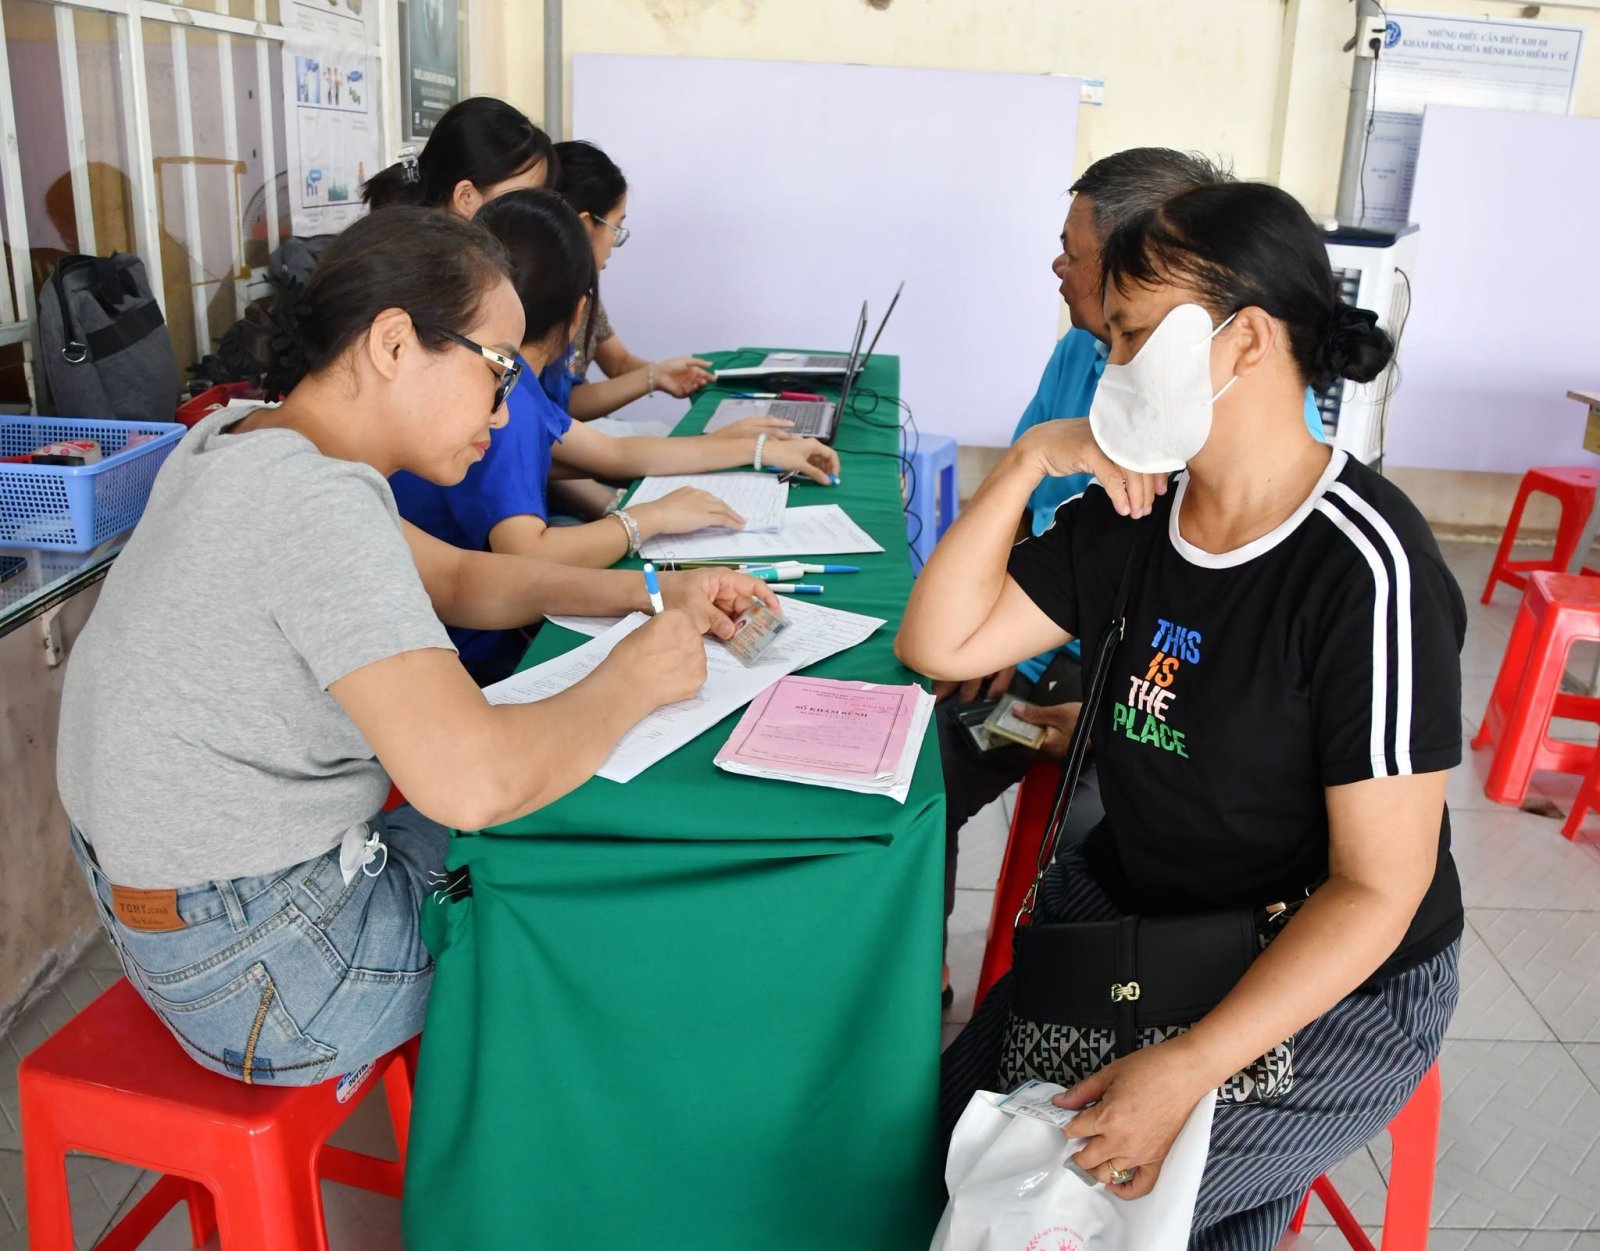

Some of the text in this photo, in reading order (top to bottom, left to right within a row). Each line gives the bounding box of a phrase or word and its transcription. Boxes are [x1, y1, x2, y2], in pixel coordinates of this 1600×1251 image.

[1151, 618, 1202, 665] THIS
[1145, 651, 1180, 688] IS
[1128, 675, 1176, 722] THE
[1113, 702, 1189, 758] PLACE
